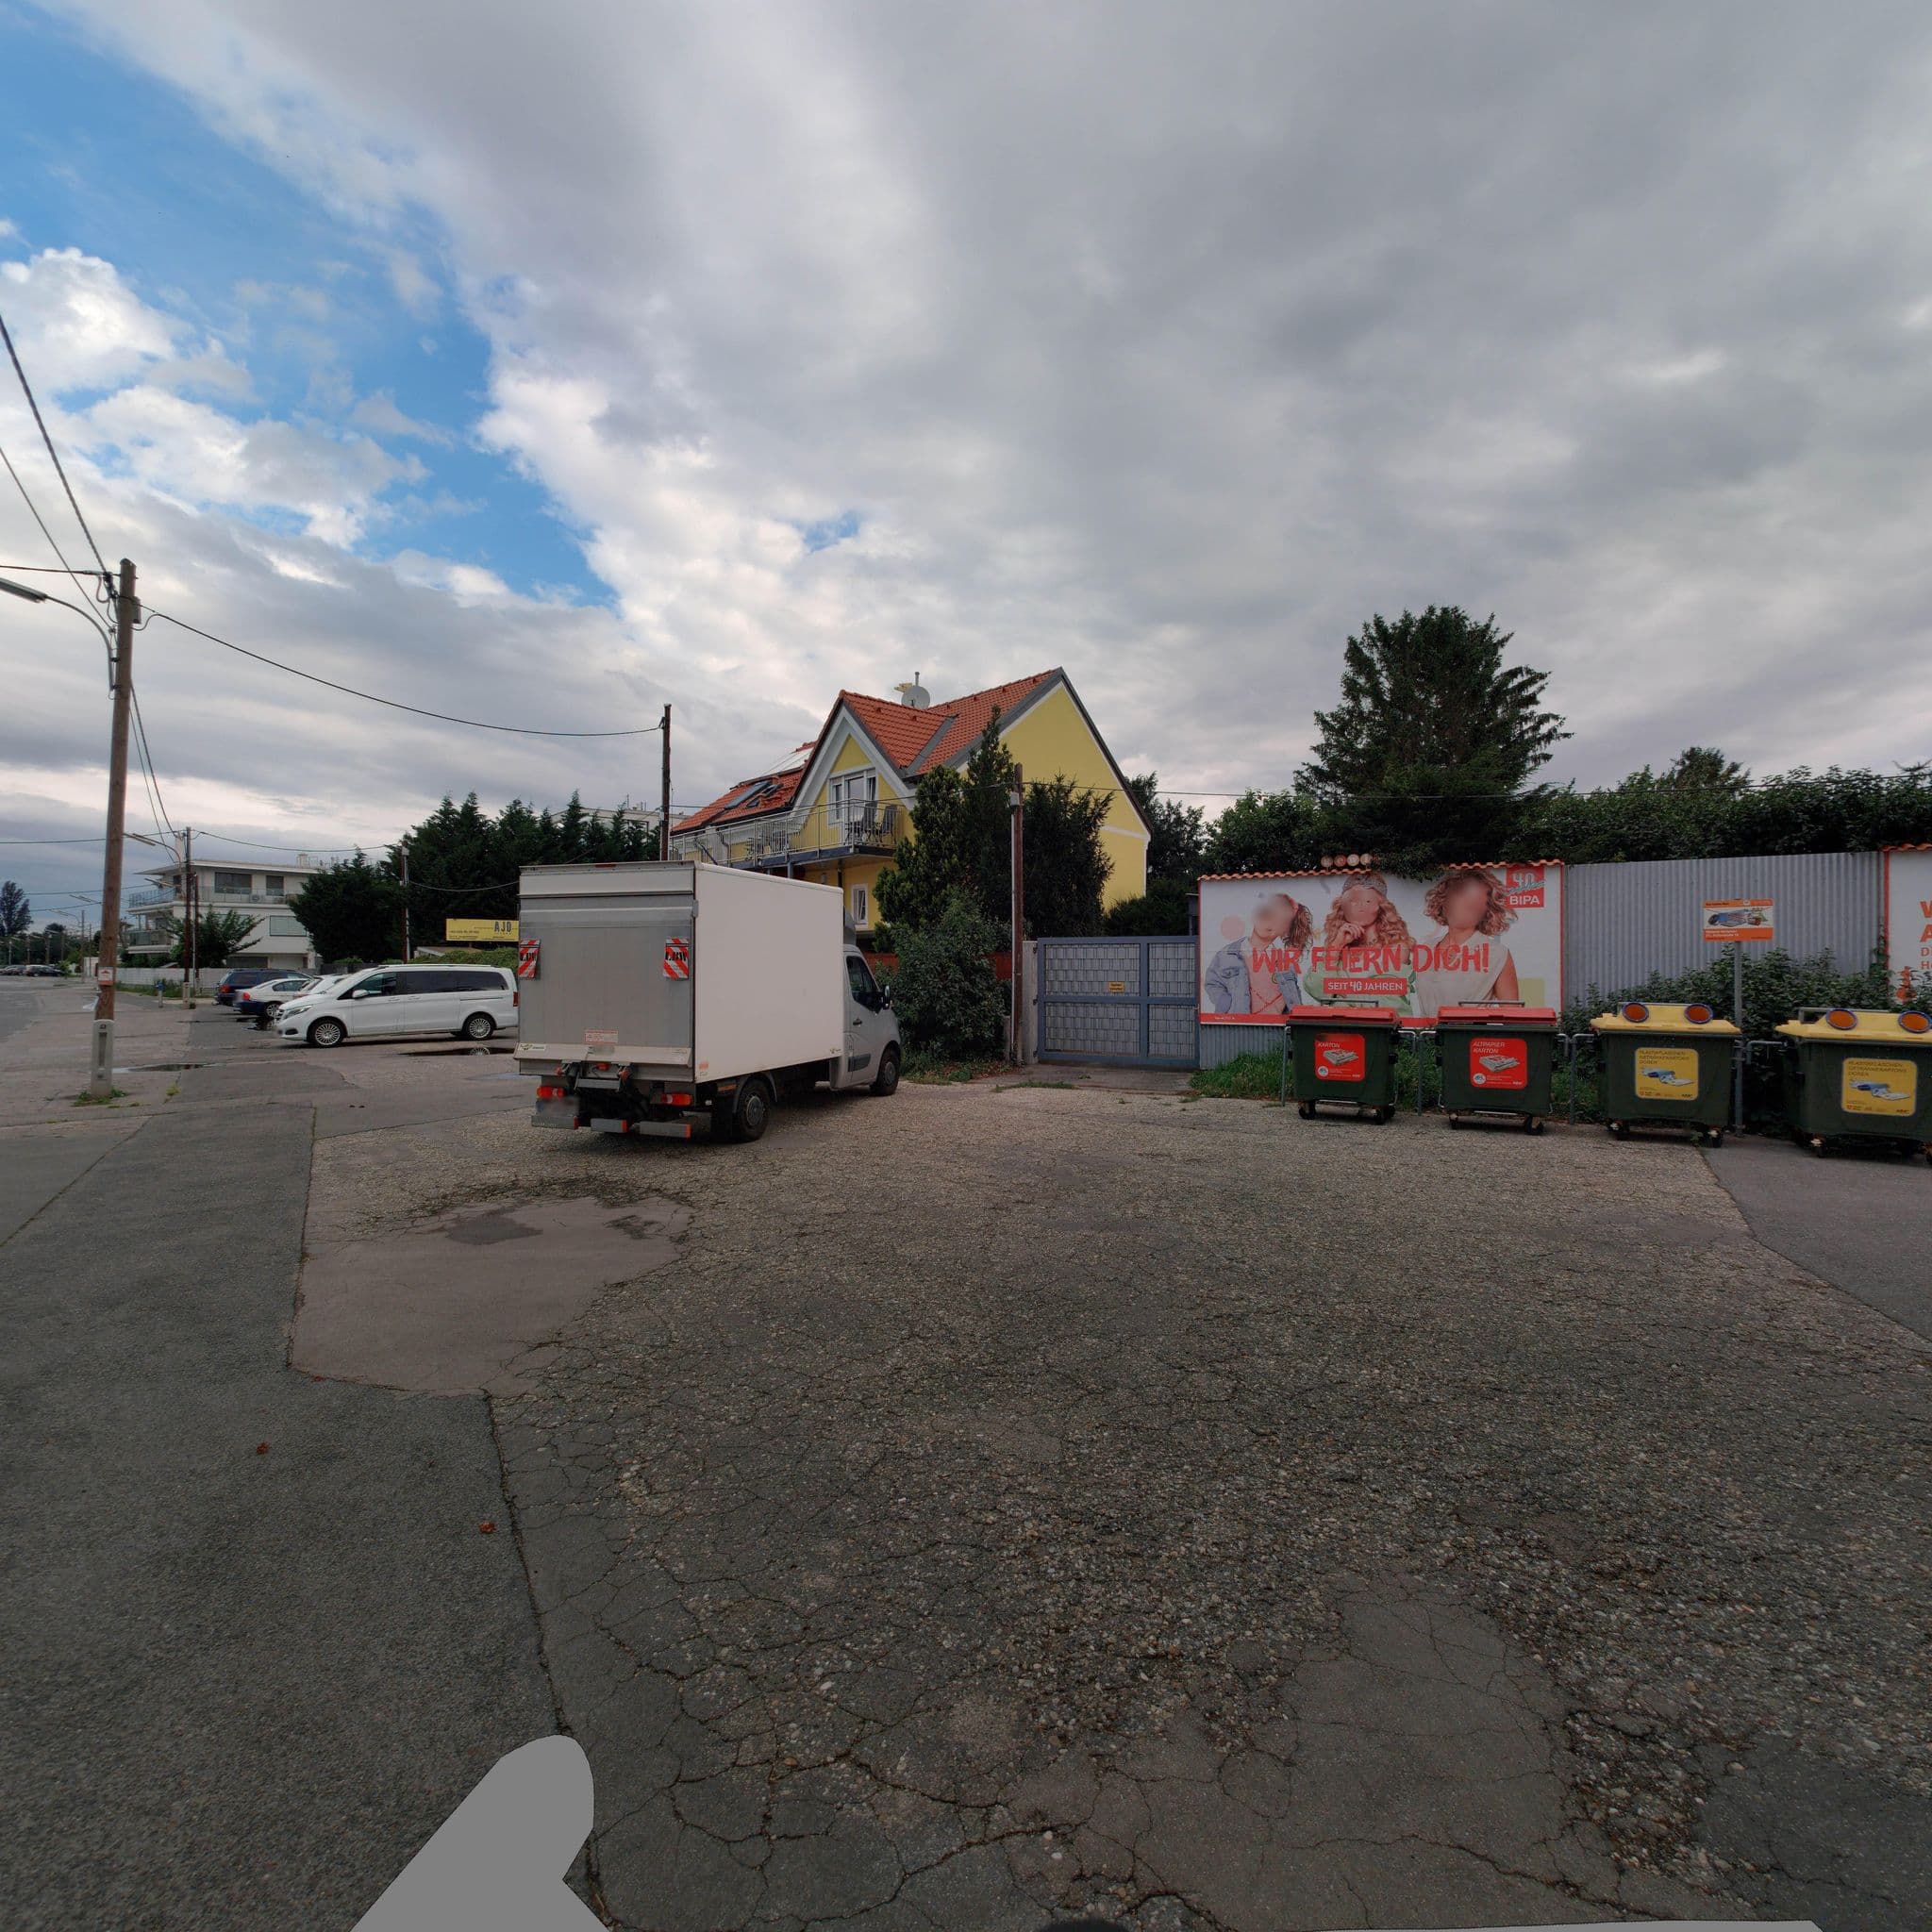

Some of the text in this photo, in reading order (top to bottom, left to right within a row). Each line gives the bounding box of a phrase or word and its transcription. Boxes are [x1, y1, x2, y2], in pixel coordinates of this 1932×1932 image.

[1509, 894, 1540, 906] BIPA
[1252, 943, 1489, 974] WIR FEIERN DICH!
[1327, 981, 1404, 991] SEIT 40 JAHREN
